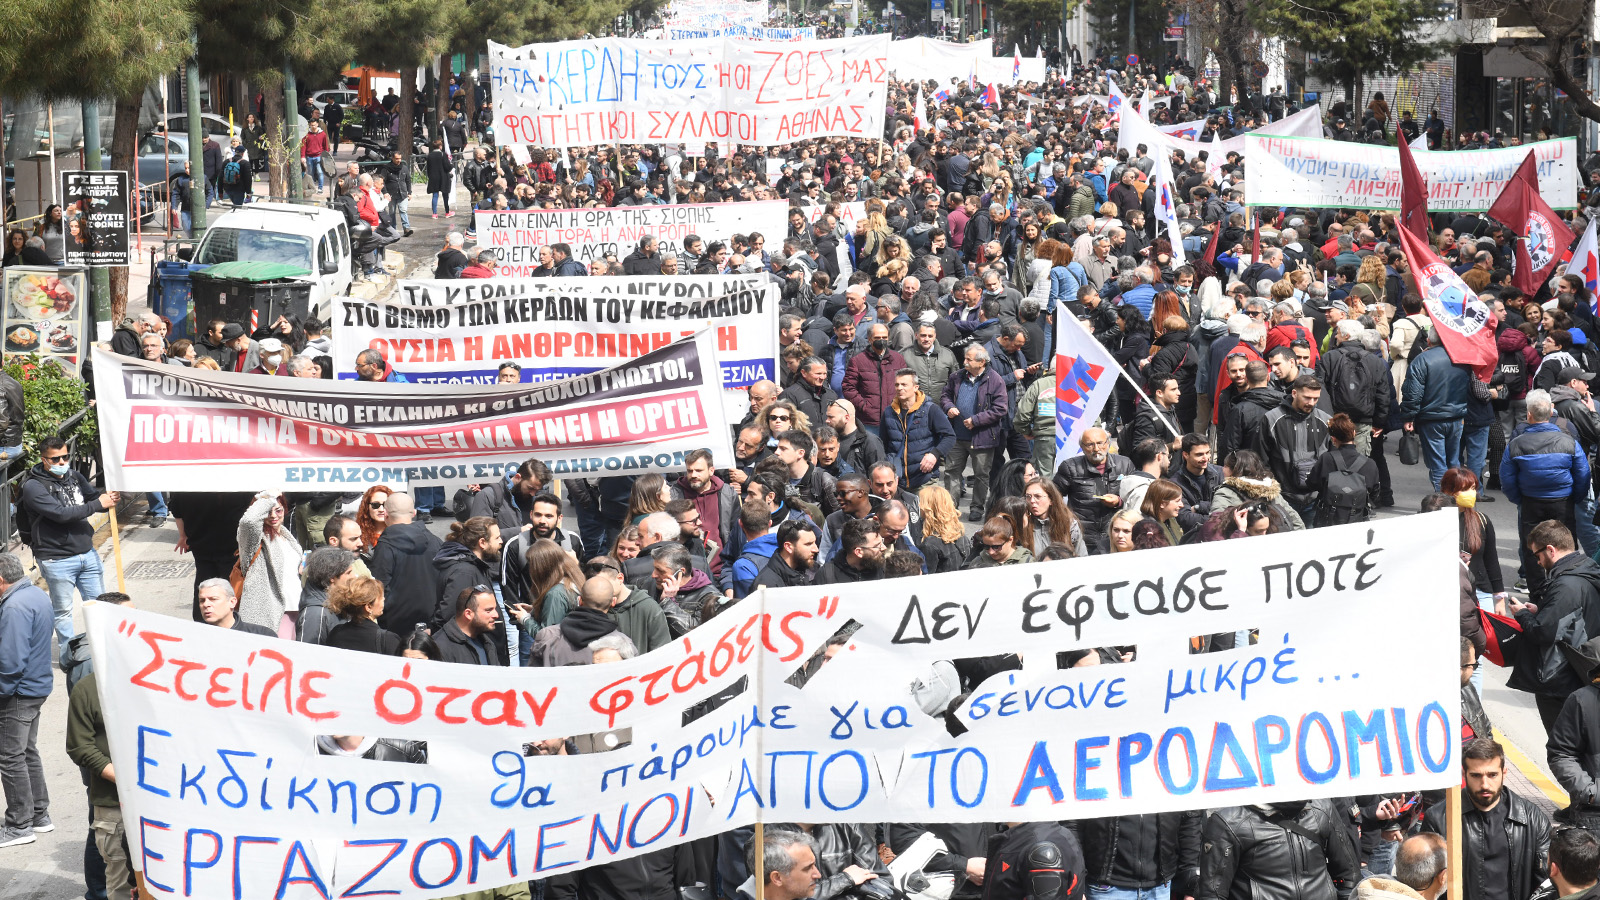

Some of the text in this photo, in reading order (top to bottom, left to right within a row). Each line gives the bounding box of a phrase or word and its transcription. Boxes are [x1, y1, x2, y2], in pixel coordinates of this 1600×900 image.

[508, 67, 539, 94] ΤΑ
[546, 46, 639, 106] ΚΕΡΔΗ
[647, 63, 707, 89] ΤΟΥΣ
[842, 58, 887, 84] ΜΑΣ
[503, 105, 865, 145] ΦΟΙΤΗΤΙΚΟΙ ΣΥΛΛΟΓΟΙ ΑΘΗΝΑΣ
[68, 174, 119, 185] ΓΣΕΕ
[491, 206, 716, 229] ΔΕΝ ΕΙΝΑΙ Η ΩΡΑ ΤΗΣ ΣΙΩΠΗΣ
[492, 231, 511, 246] ΝΑ
[516, 229, 548, 246] ΓΙΝΕΙ
[555, 227, 594, 244] ΤΩΡΑ
[601, 227, 610, 242] Η
[342, 288, 766, 329] ΣΤΟ ΒΩΜΟ ΤΩΝ ΚΕΡΔΩΝ ΤΟΥ ΚΕΦΑΛΑΙΟΥ
[403, 285, 433, 306] ΤΑ
[463, 336, 484, 361] Η
[720, 363, 768, 383] ΕΣ/ΝΑ
[1500, 363, 1520, 374] VANS
[354, 404, 458, 425] ΕΓΚΛΗΜΑ
[463, 402, 486, 414] ΚΙ
[599, 357, 694, 393] ΓΝΩΣΤΟΙ,
[133, 413, 249, 444] ΠΟΤΑΜΙ
[256, 415, 298, 445] ΝΑ
[303, 423, 376, 448] ΤΟΥΣ
[473, 423, 516, 450] ΝΑ
[519, 412, 593, 447] ΓΙΝΕΙ
[597, 408, 620, 437] Η
[624, 396, 700, 435] ΟΡΓΗ
[285, 465, 468, 483] ΕΡΓΑΖΟΜΕΝΟΙ
[542, 447, 713, 474] ΙΔΗΡΟΔΡΟΜ
[372, 662, 558, 729] όταν
[891, 594, 990, 645] Δεν
[1020, 566, 1230, 641] έφτασε
[1262, 527, 1385, 603] ποτέ
[137, 723, 443, 826] Εκδίκηση
[490, 749, 556, 809] θα
[600, 704, 798, 793] πάρουμε
[829, 699, 914, 741] για
[968, 673, 1129, 721] σένανε
[139, 699, 1452, 900] ΕΡΓΑΖΟΜΕΝΟΙ ΑΠΟ ΤΟ ΑΕΡΟΔΡΟΜΙΟ
